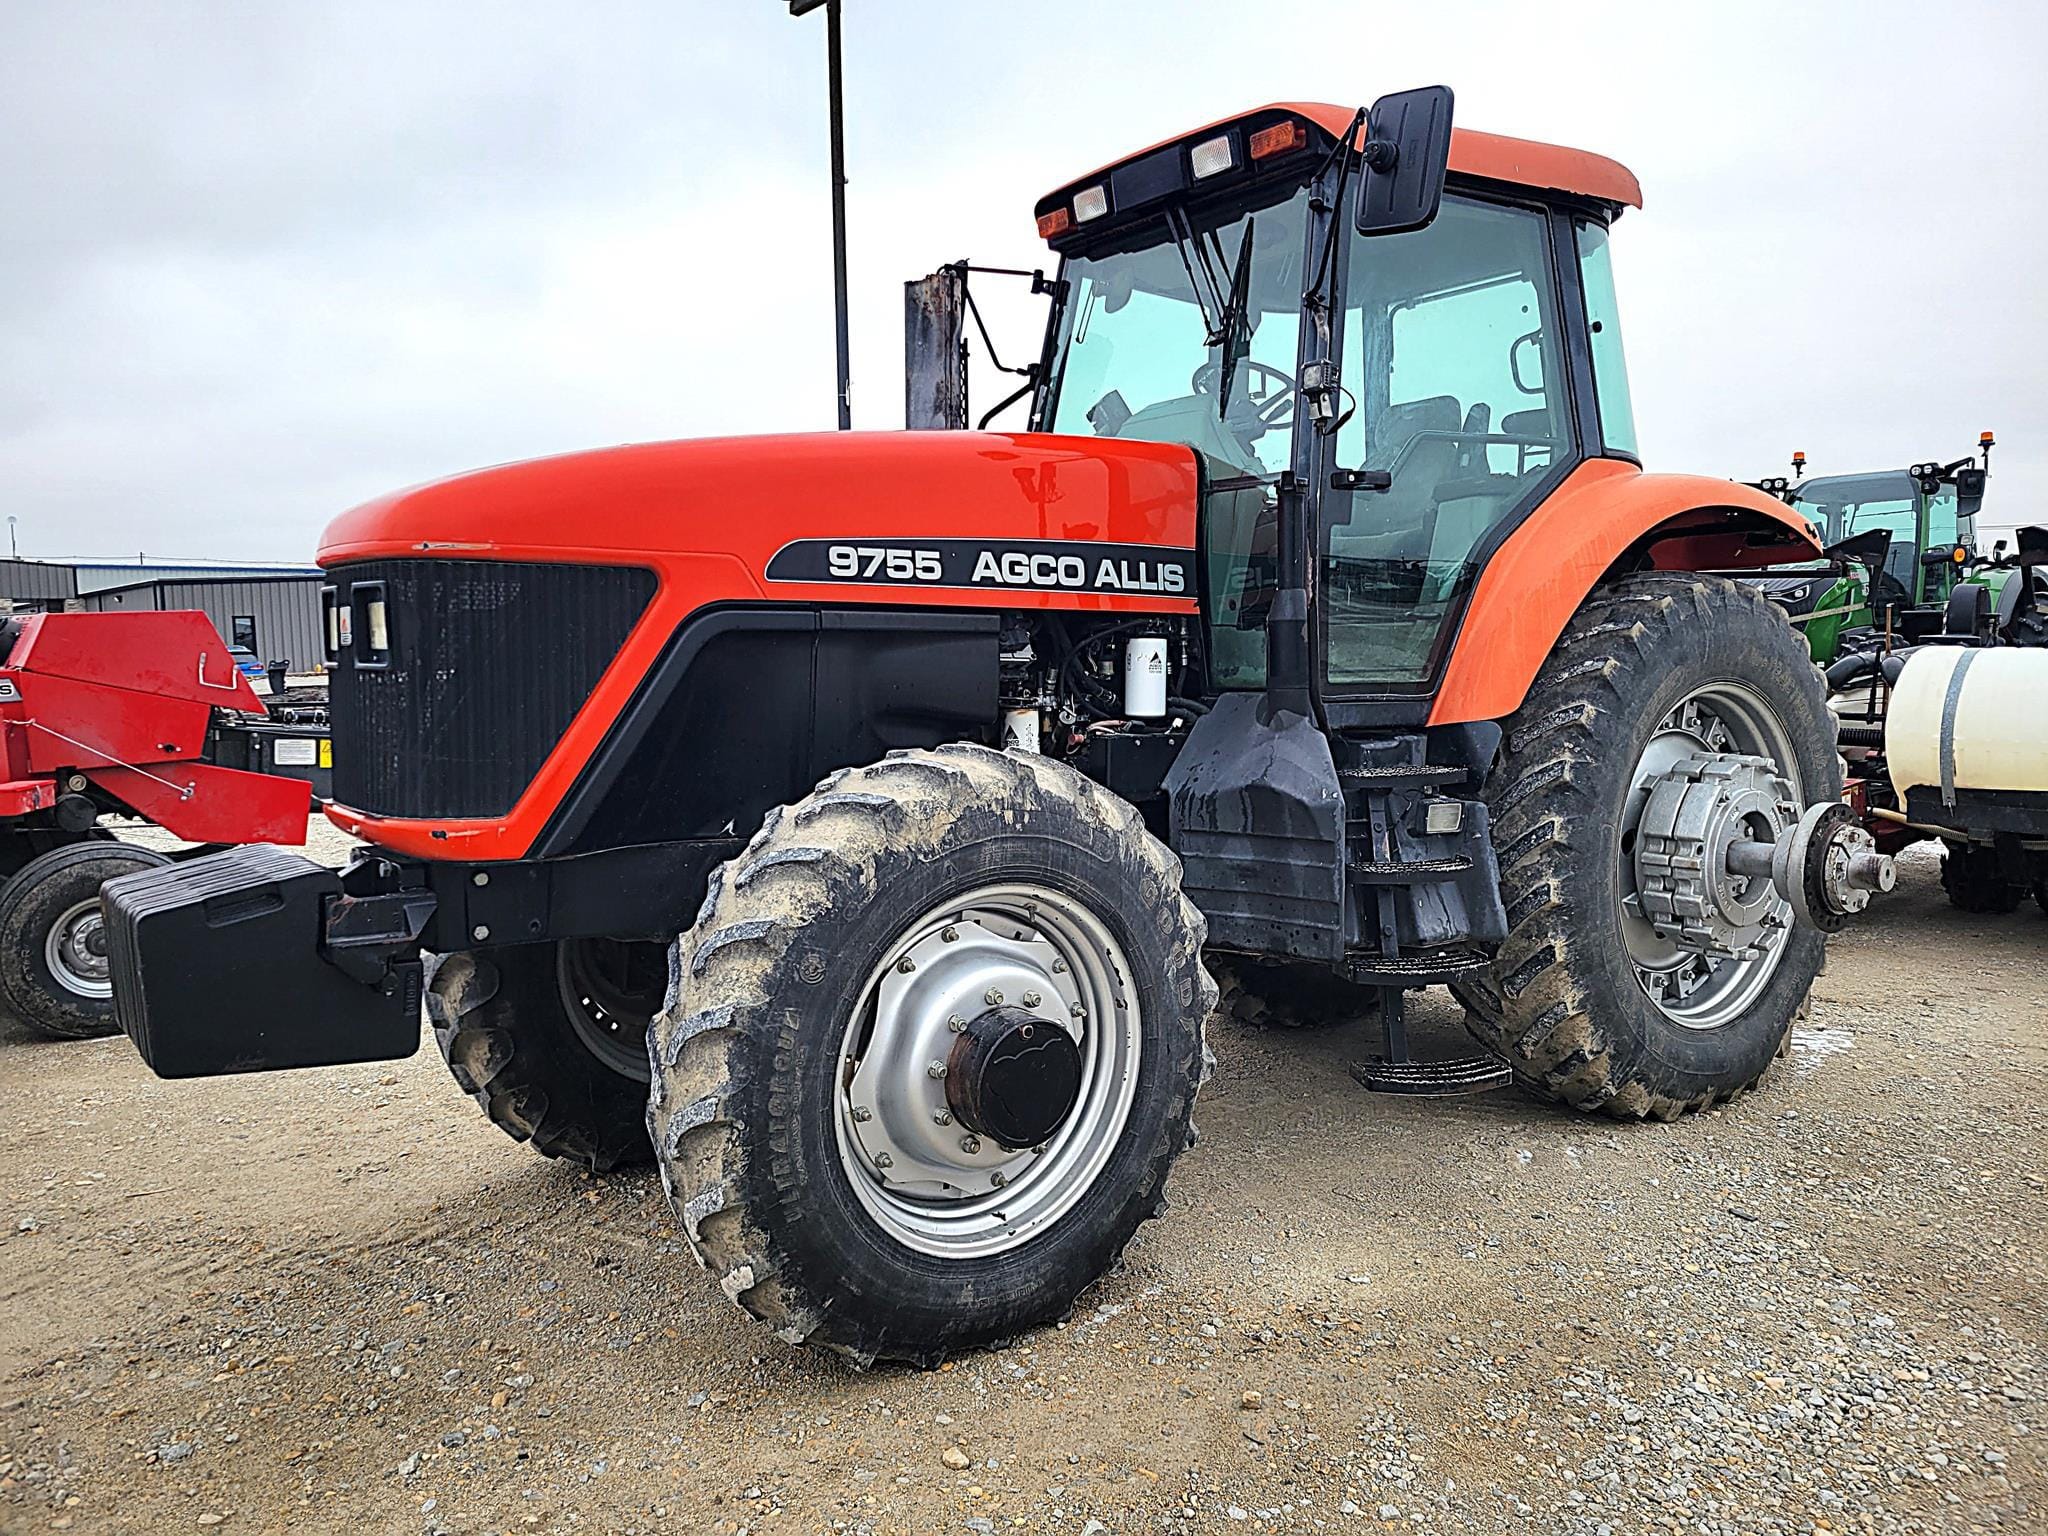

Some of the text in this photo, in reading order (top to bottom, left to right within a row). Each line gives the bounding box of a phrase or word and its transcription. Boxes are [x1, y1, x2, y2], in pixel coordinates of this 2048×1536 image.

[829, 546, 1185, 592] 9755 AGCO ALLIS
